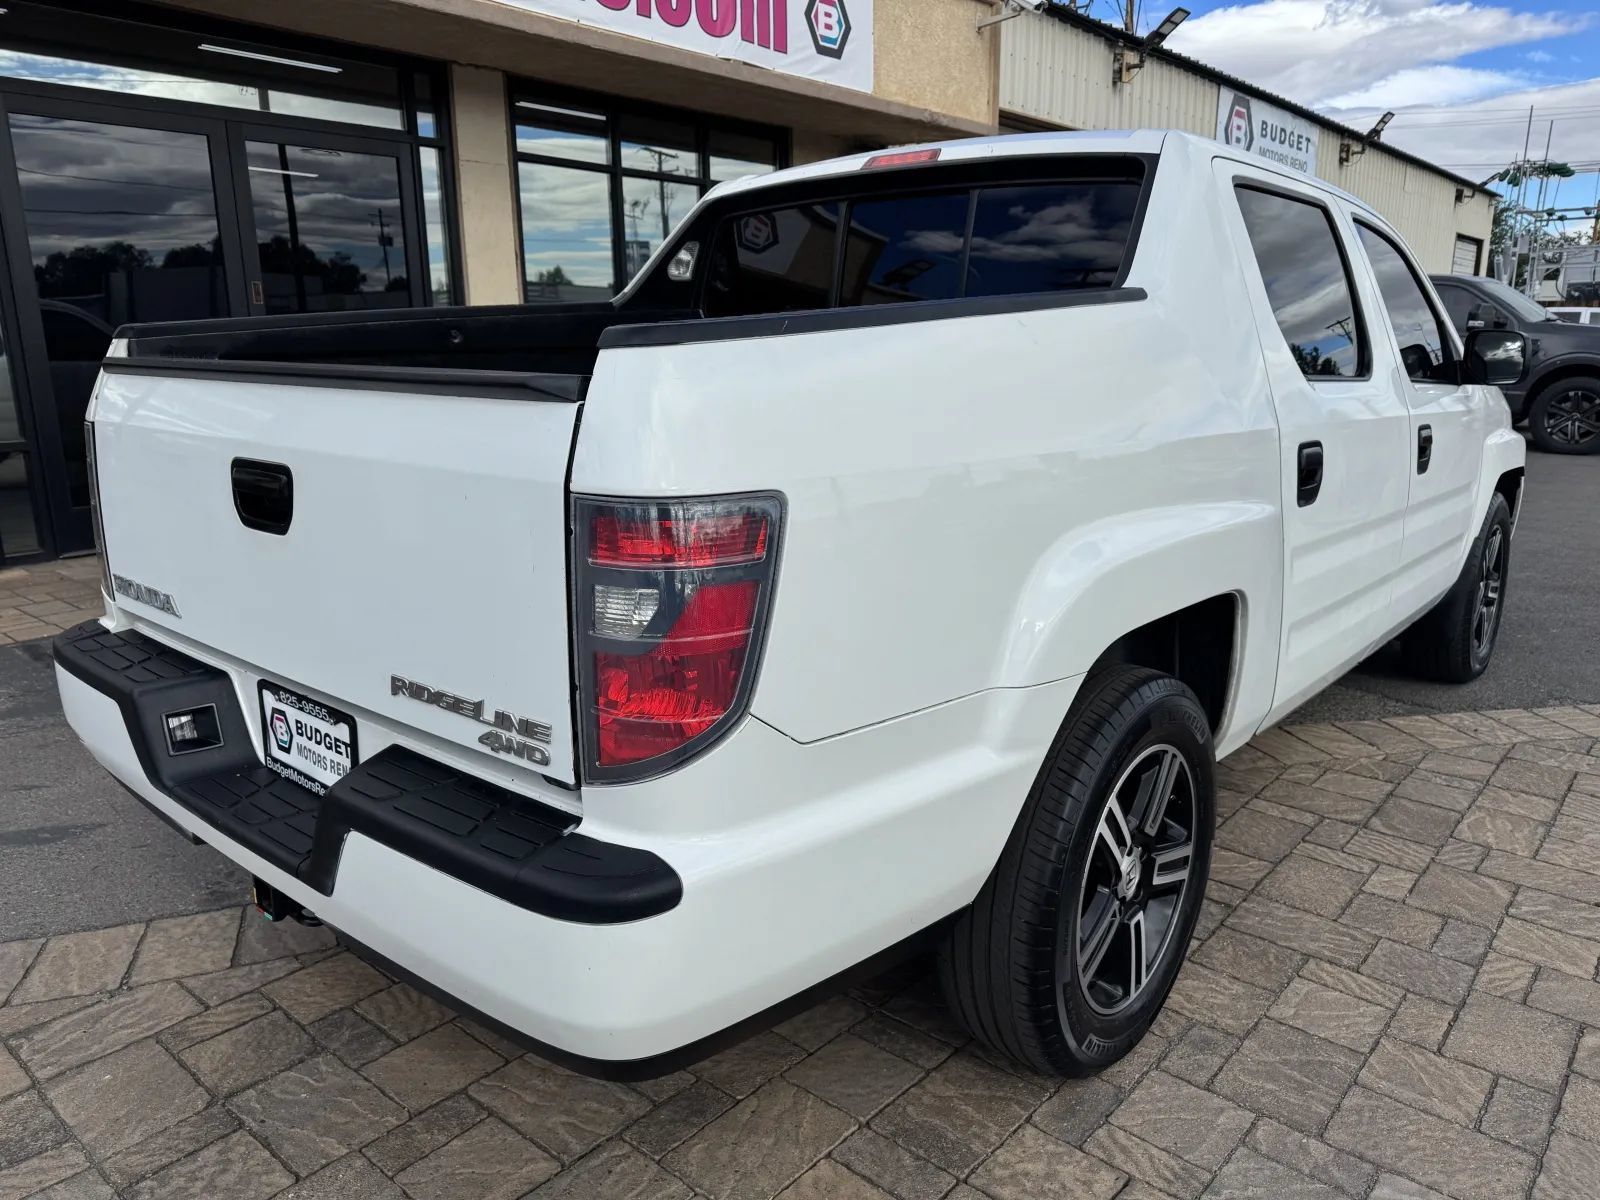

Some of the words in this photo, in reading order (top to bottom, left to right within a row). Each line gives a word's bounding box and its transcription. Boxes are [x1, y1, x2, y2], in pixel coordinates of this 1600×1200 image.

[1260, 119, 1312, 154] BUDGET
[1259, 146, 1289, 166] MOTORS
[1289, 154, 1308, 173] RENO
[112, 573, 182, 619] HONDA
[279, 691, 330, 722] 825-9555
[390, 673, 553, 744] RIDGELINE
[294, 718, 351, 759] BUDGET
[477, 729, 551, 766] 4WD
[296, 741, 329, 772] MOTORS
[329, 758, 352, 778] REN
